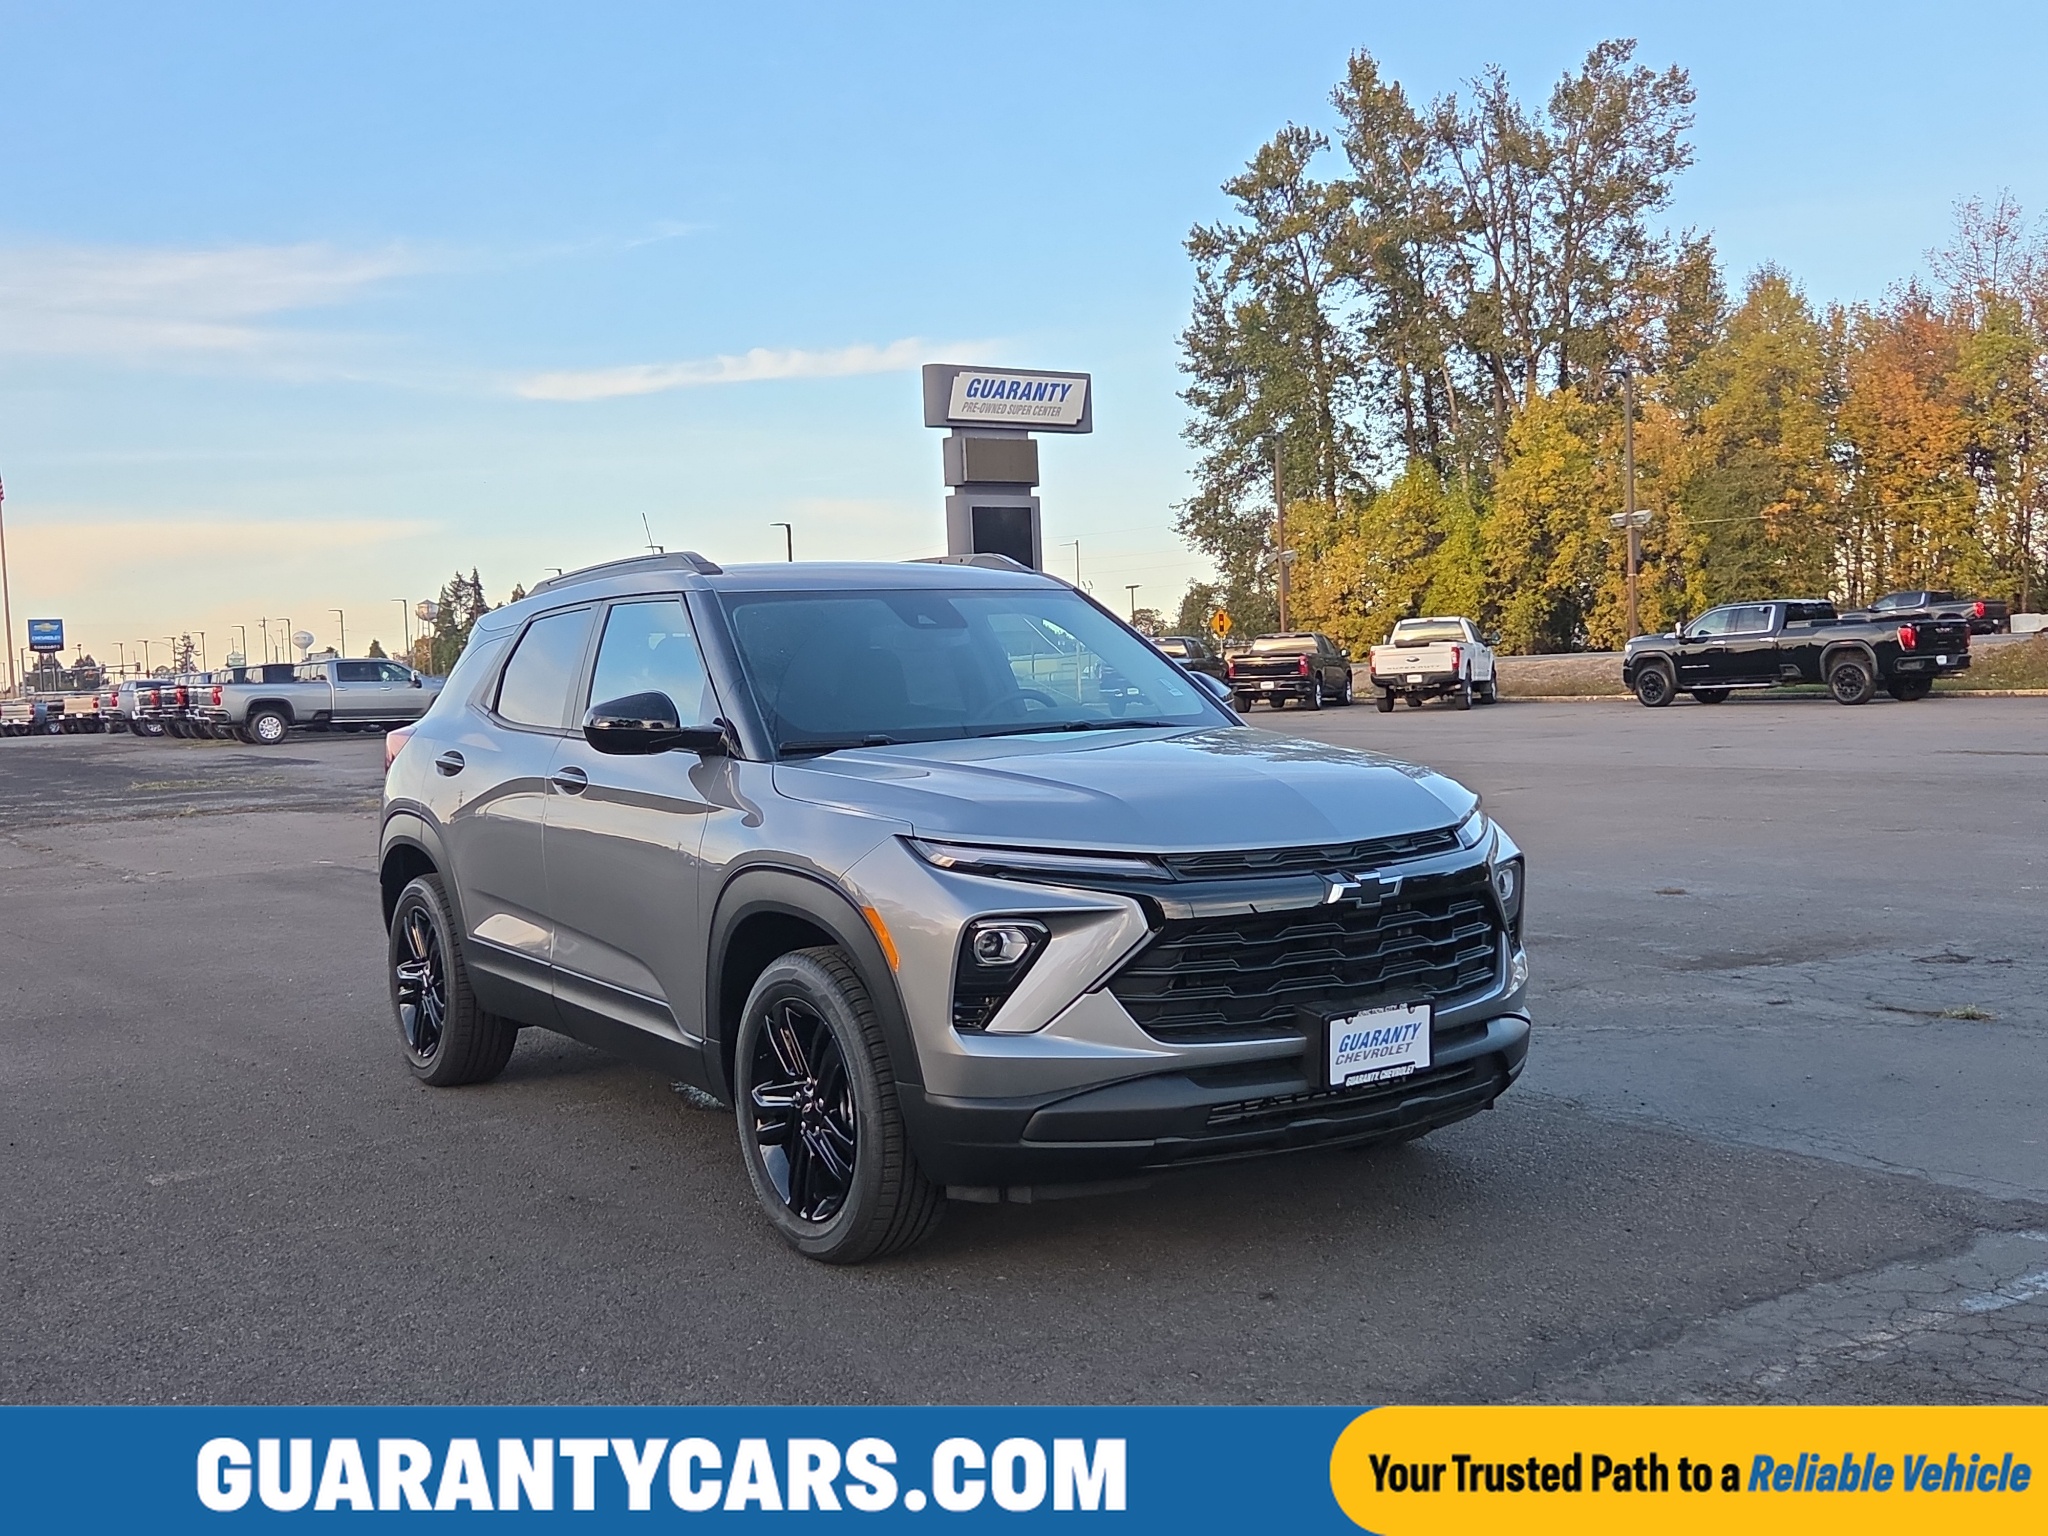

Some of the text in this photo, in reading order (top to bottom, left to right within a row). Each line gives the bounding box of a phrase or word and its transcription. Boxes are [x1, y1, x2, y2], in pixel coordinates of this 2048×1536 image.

[966, 378, 1073, 403] GUARANTY
[961, 401, 1062, 417] PRE-OWNED SUPER CENTER
[1338, 1022, 1422, 1053] GUARANTY
[1335, 1042, 1413, 1066] CHEVROLET
